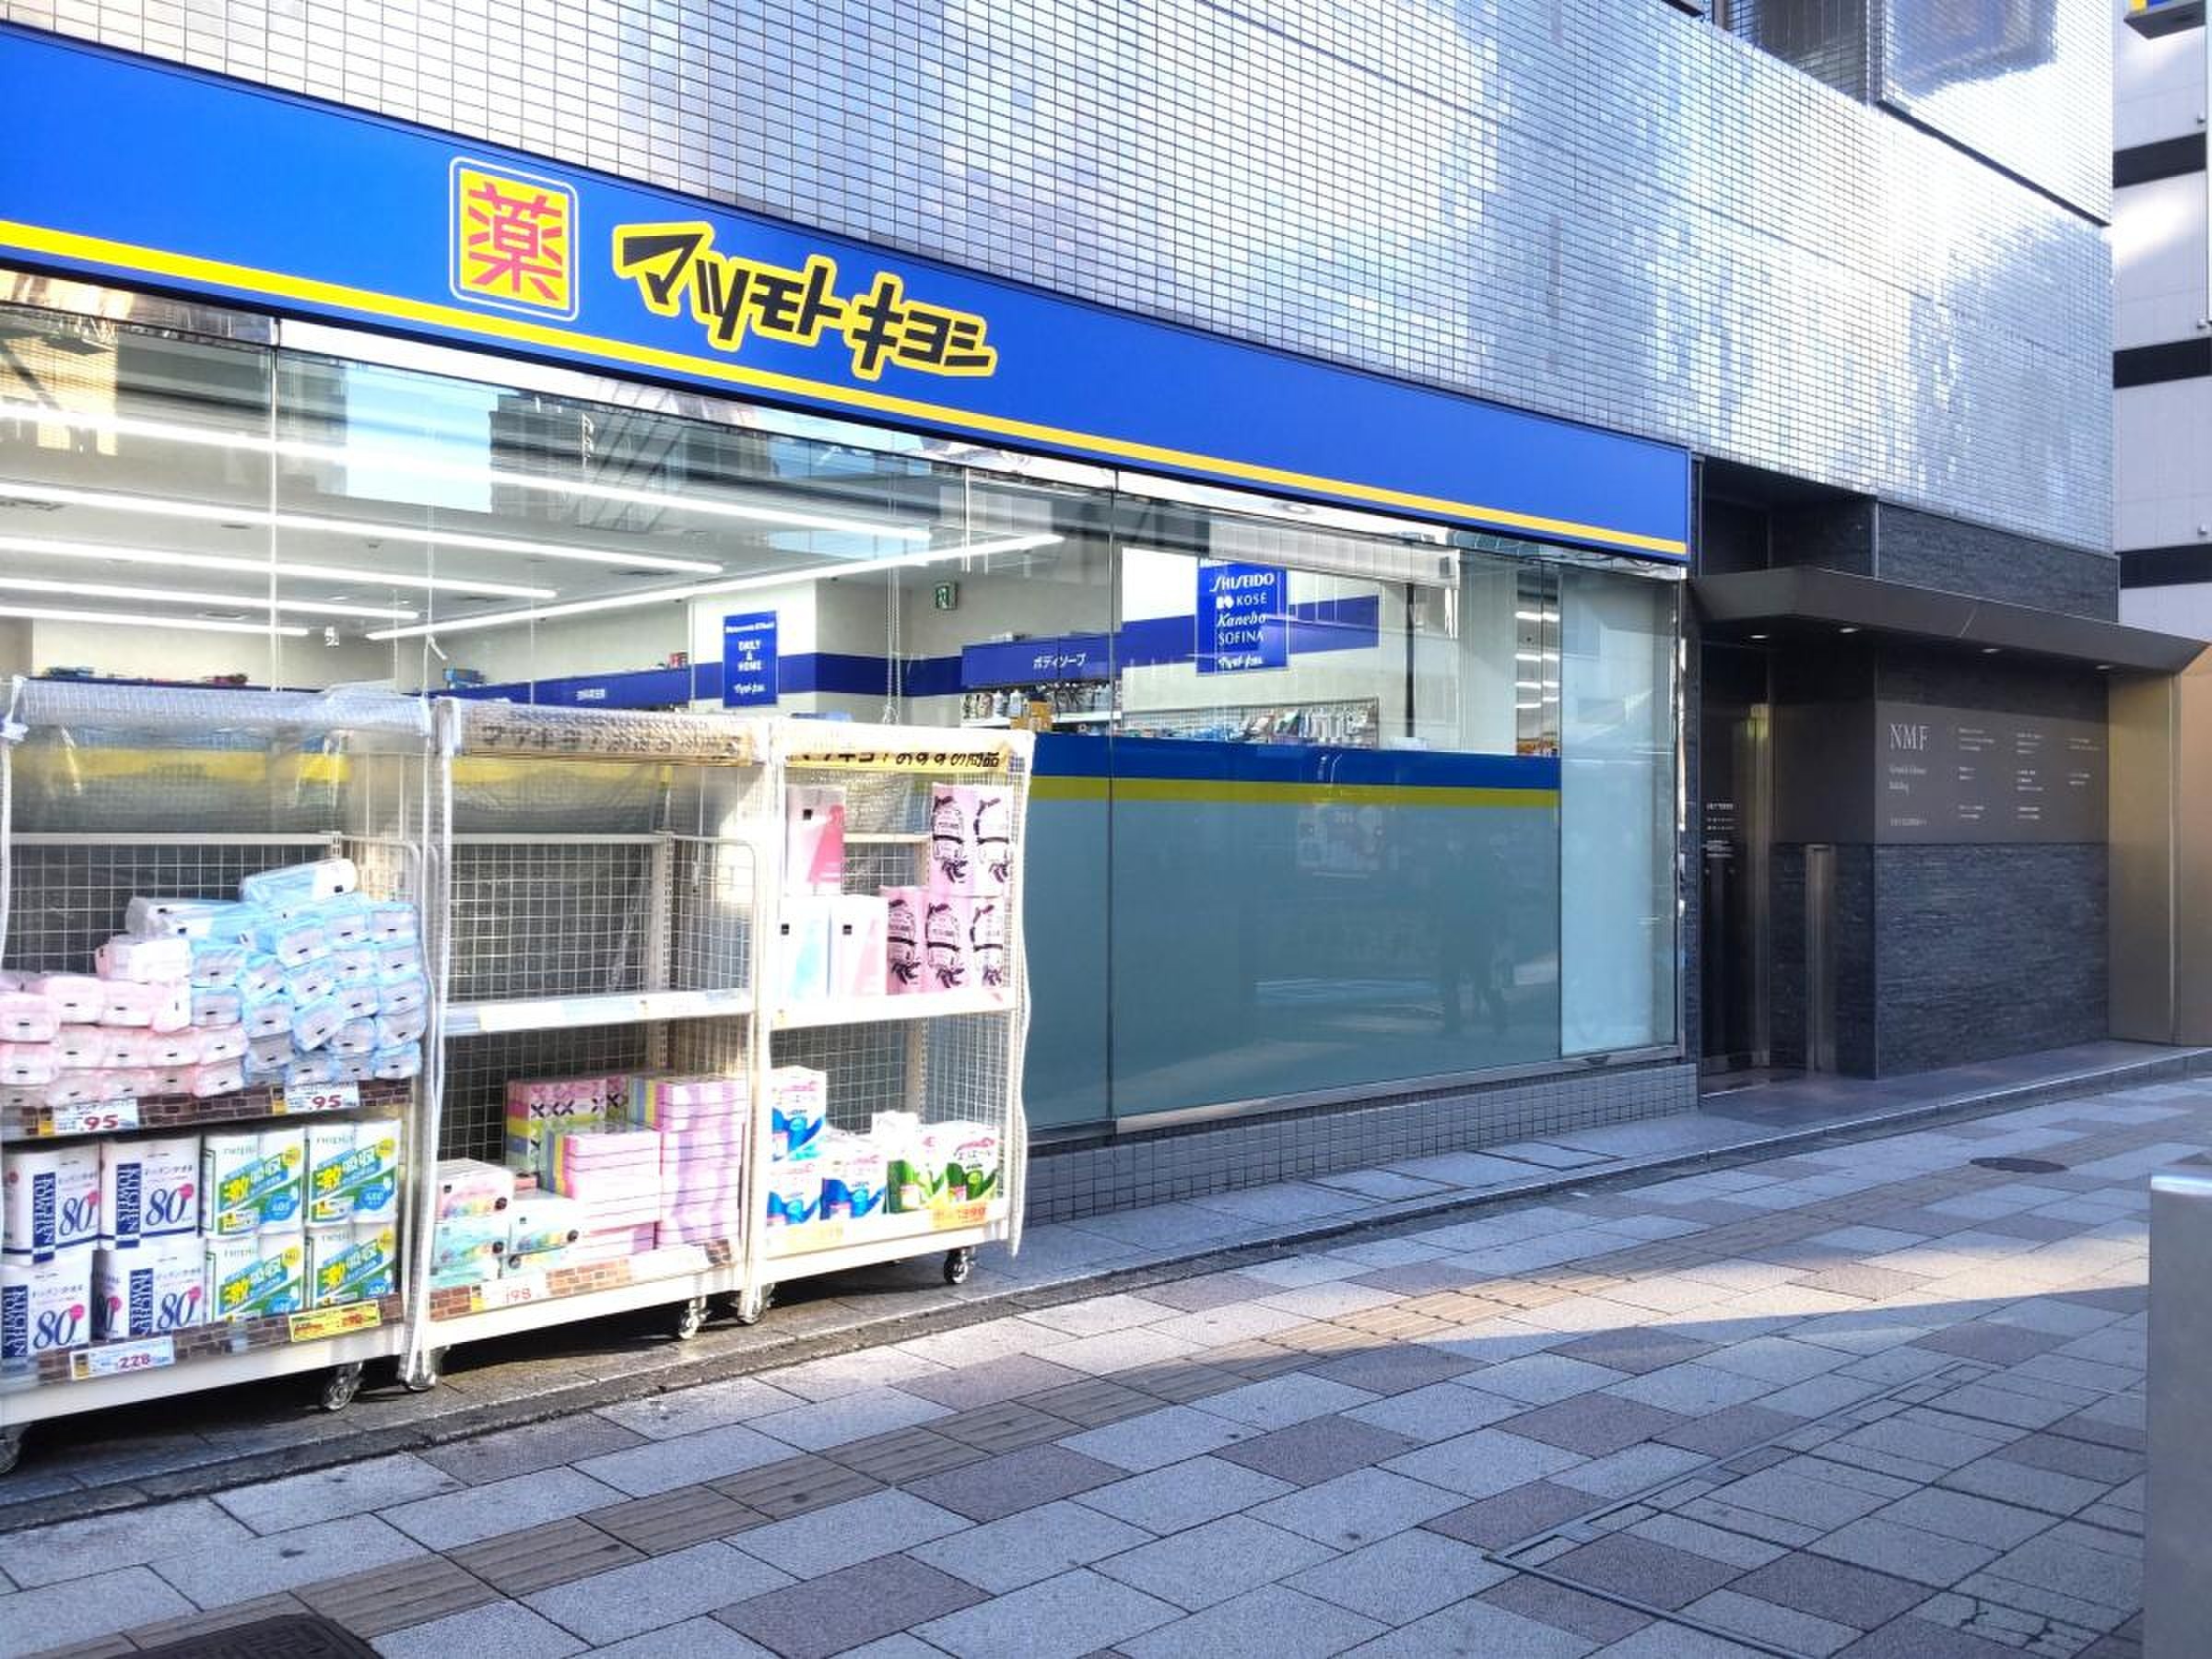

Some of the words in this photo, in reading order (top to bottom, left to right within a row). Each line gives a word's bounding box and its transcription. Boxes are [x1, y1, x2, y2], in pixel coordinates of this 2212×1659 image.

[465, 180, 564, 302] 薬
[618, 226, 995, 374] マツモトキヨシ
[1209, 573, 1275, 593] SHISEIDO
[1217, 610, 1267, 628] Kanebo
[1218, 629, 1265, 646] SOFINA
[1888, 724, 1931, 751] NMF
[312, 1094, 342, 1109] 95
[84, 1113, 119, 1131] 95
[59, 1196, 93, 1237] 80
[146, 1188, 185, 1226] 80
[157, 1292, 195, 1329] 80
[33, 1310, 76, 1349] 80
